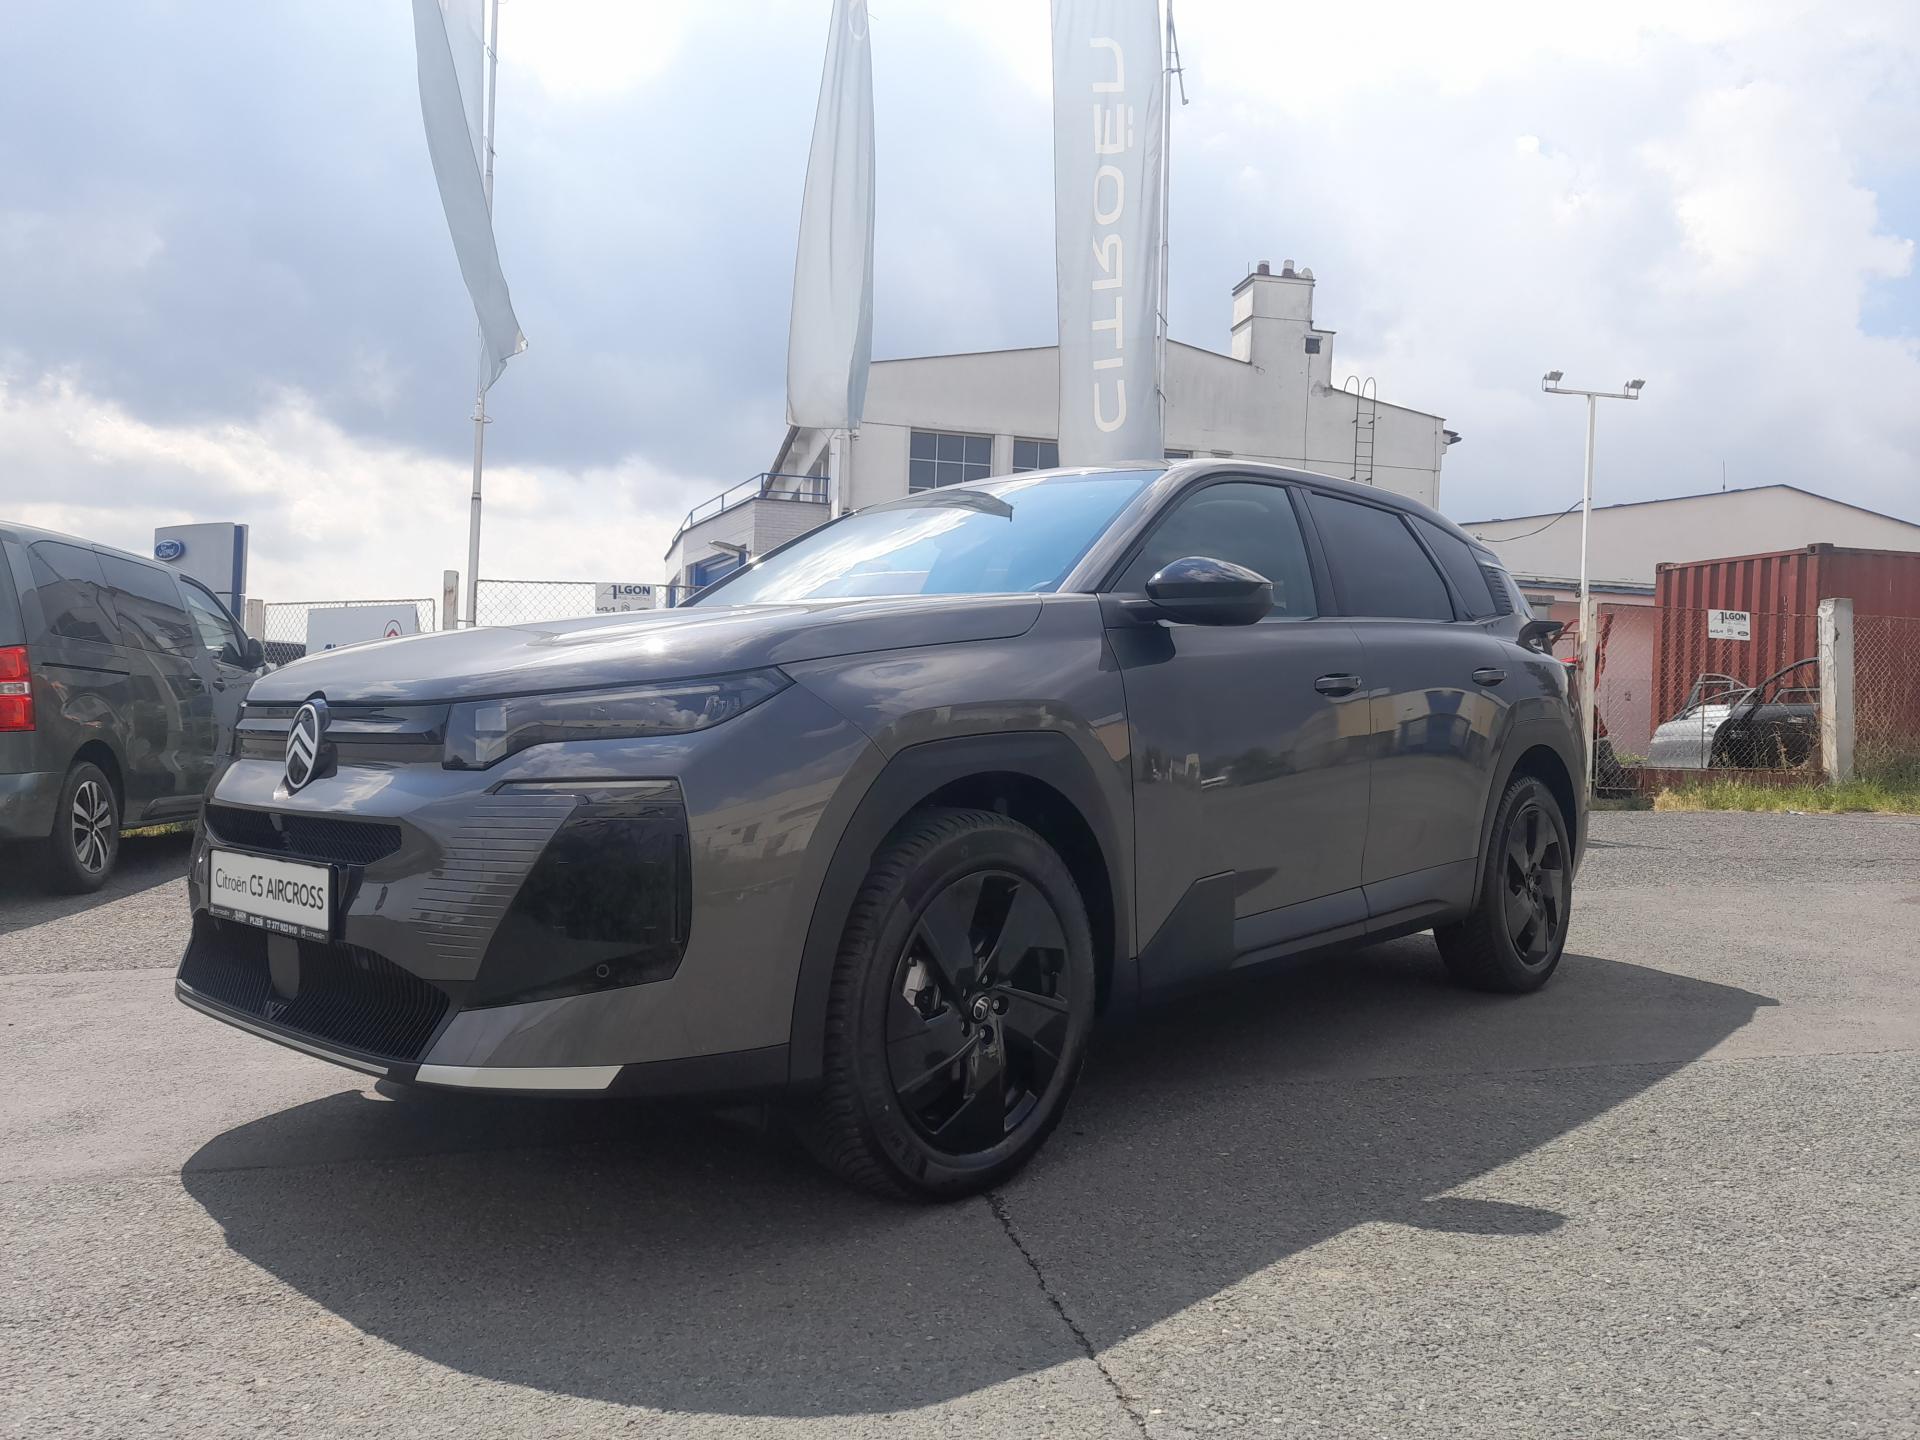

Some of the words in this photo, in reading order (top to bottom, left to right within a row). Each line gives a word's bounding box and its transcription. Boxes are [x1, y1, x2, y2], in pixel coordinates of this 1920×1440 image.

[215, 867, 247, 894] Citroën
[249, 874, 264, 898] C5
[266, 878, 324, 910] AIRCROSS
